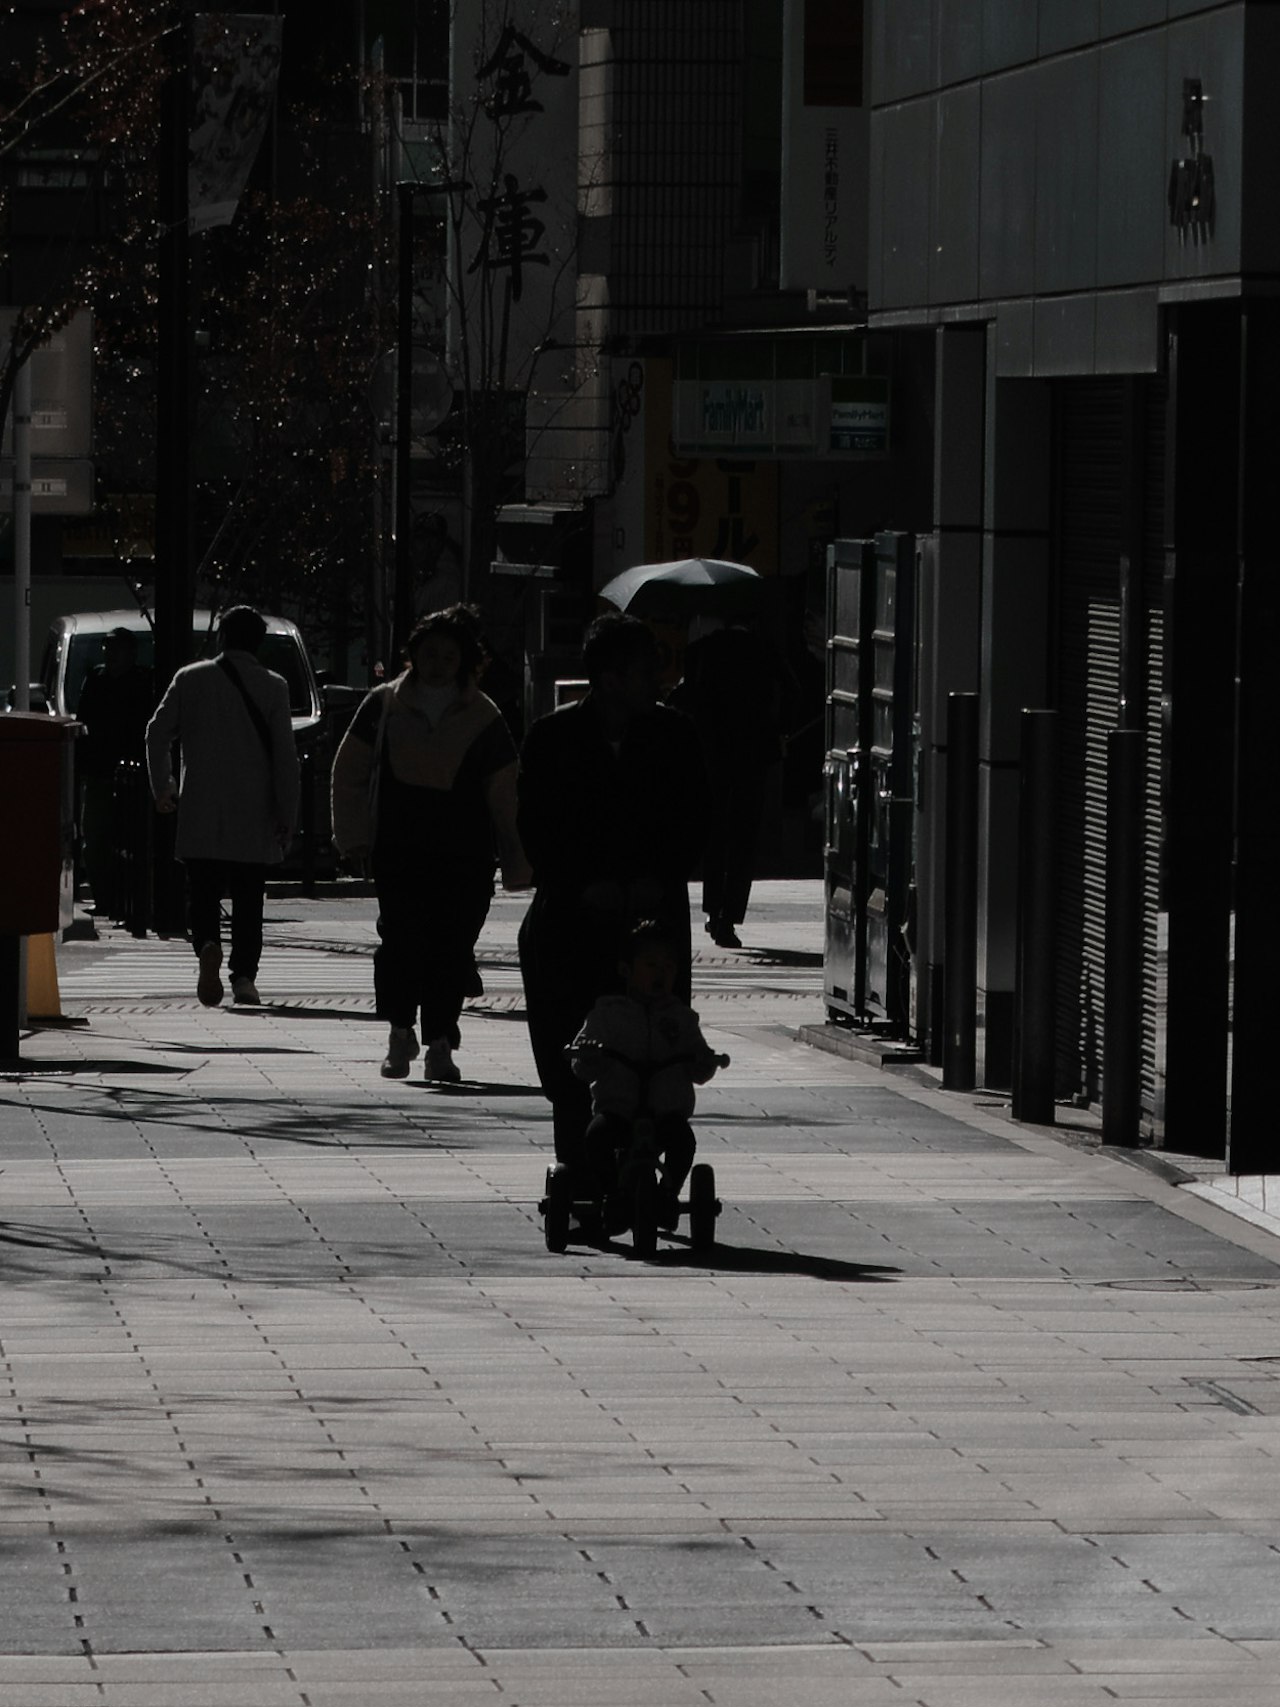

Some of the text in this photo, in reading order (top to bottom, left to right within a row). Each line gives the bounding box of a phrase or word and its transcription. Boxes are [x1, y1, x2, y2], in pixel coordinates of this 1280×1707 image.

[467, 25, 570, 302] 金庫
[824, 127, 839, 268] 三井不動産リアルティ
[703, 389, 764, 434] FamilyMart
[832, 408, 885, 421] FamilyMart
